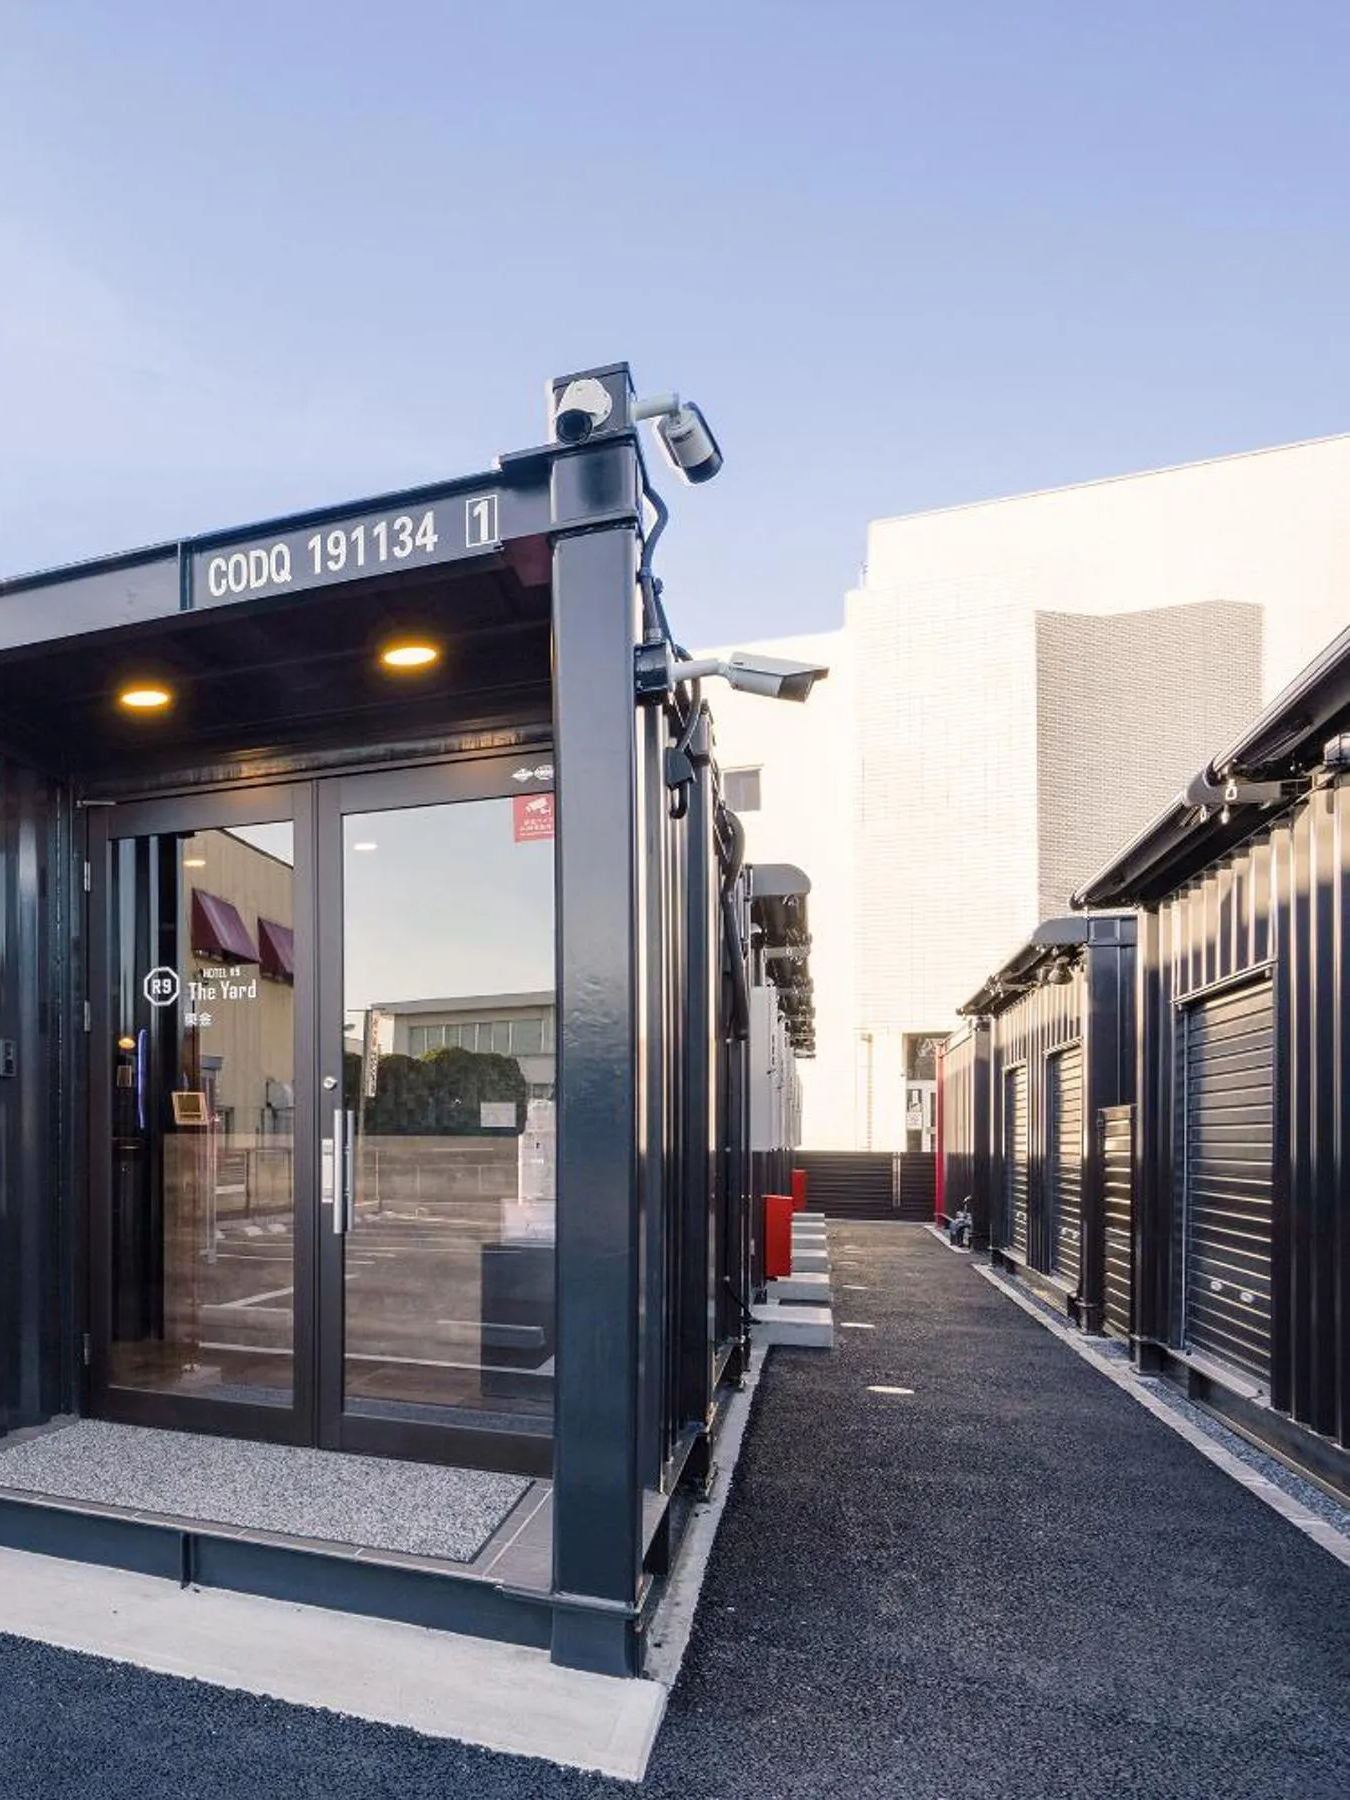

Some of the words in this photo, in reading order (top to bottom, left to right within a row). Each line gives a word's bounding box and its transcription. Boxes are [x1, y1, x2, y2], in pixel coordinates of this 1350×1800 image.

[208, 543, 293, 597] CODQ
[308, 510, 439, 575] 191134
[151, 978, 172, 995] R9
[188, 982, 216, 1001] The
[219, 979, 257, 1000] Yard
